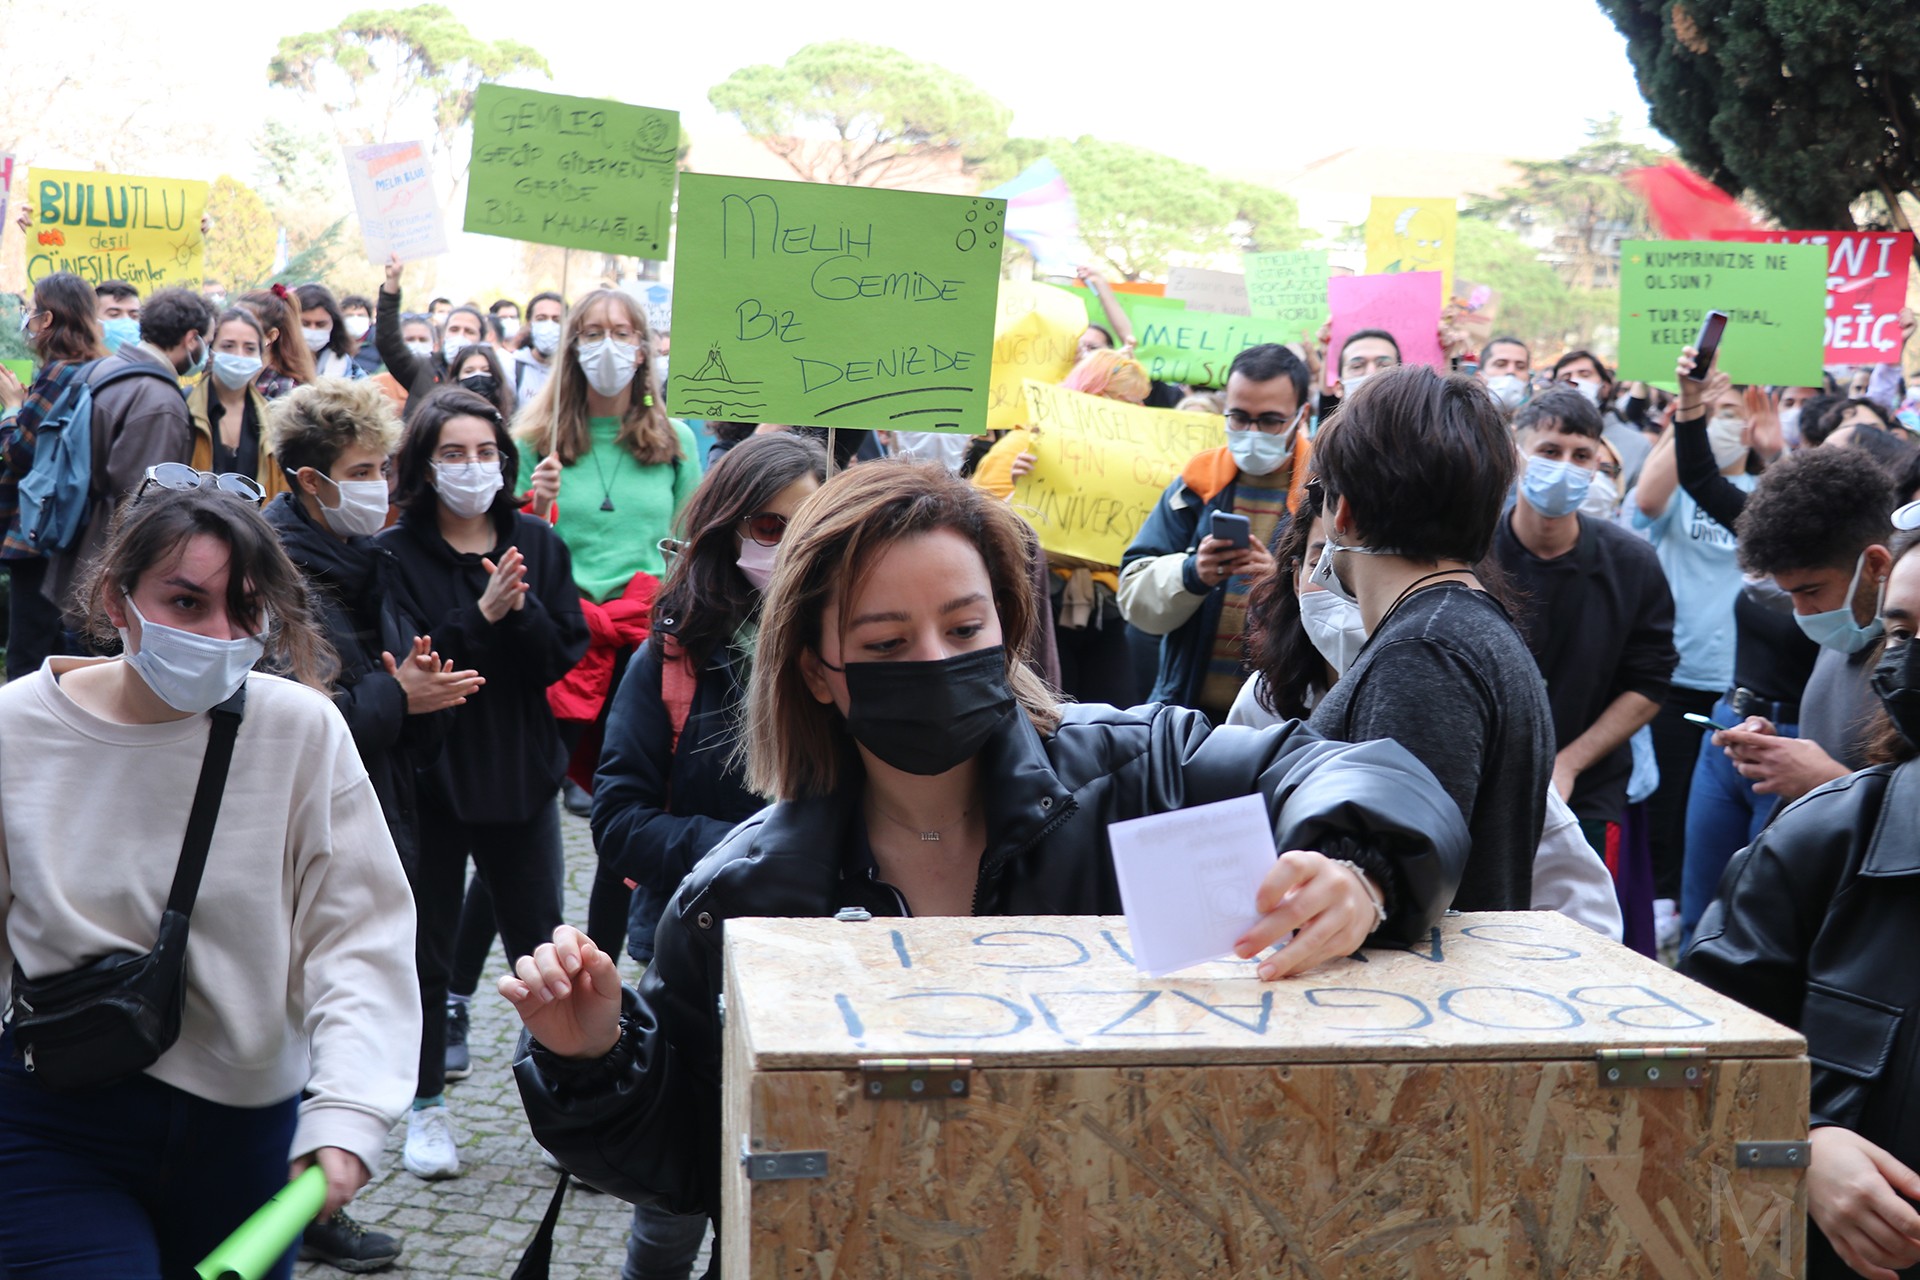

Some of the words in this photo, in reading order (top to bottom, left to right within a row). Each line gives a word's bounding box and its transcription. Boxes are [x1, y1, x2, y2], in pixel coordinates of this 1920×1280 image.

[40, 180, 185, 230] BULUTLU
[721, 193, 872, 259] MELİH
[811, 254, 966, 301] GEMİDE
[1765, 254, 1789, 271] NE
[735, 298, 805, 342] BİZ
[1276, 306, 1319, 321] KORU
[1651, 327, 1702, 345] KELEP
[1714, 308, 1782, 328] TİHAL,
[792, 344, 976, 394] DENİZDE
[1028, 384, 1145, 444] BİLİMSEL
